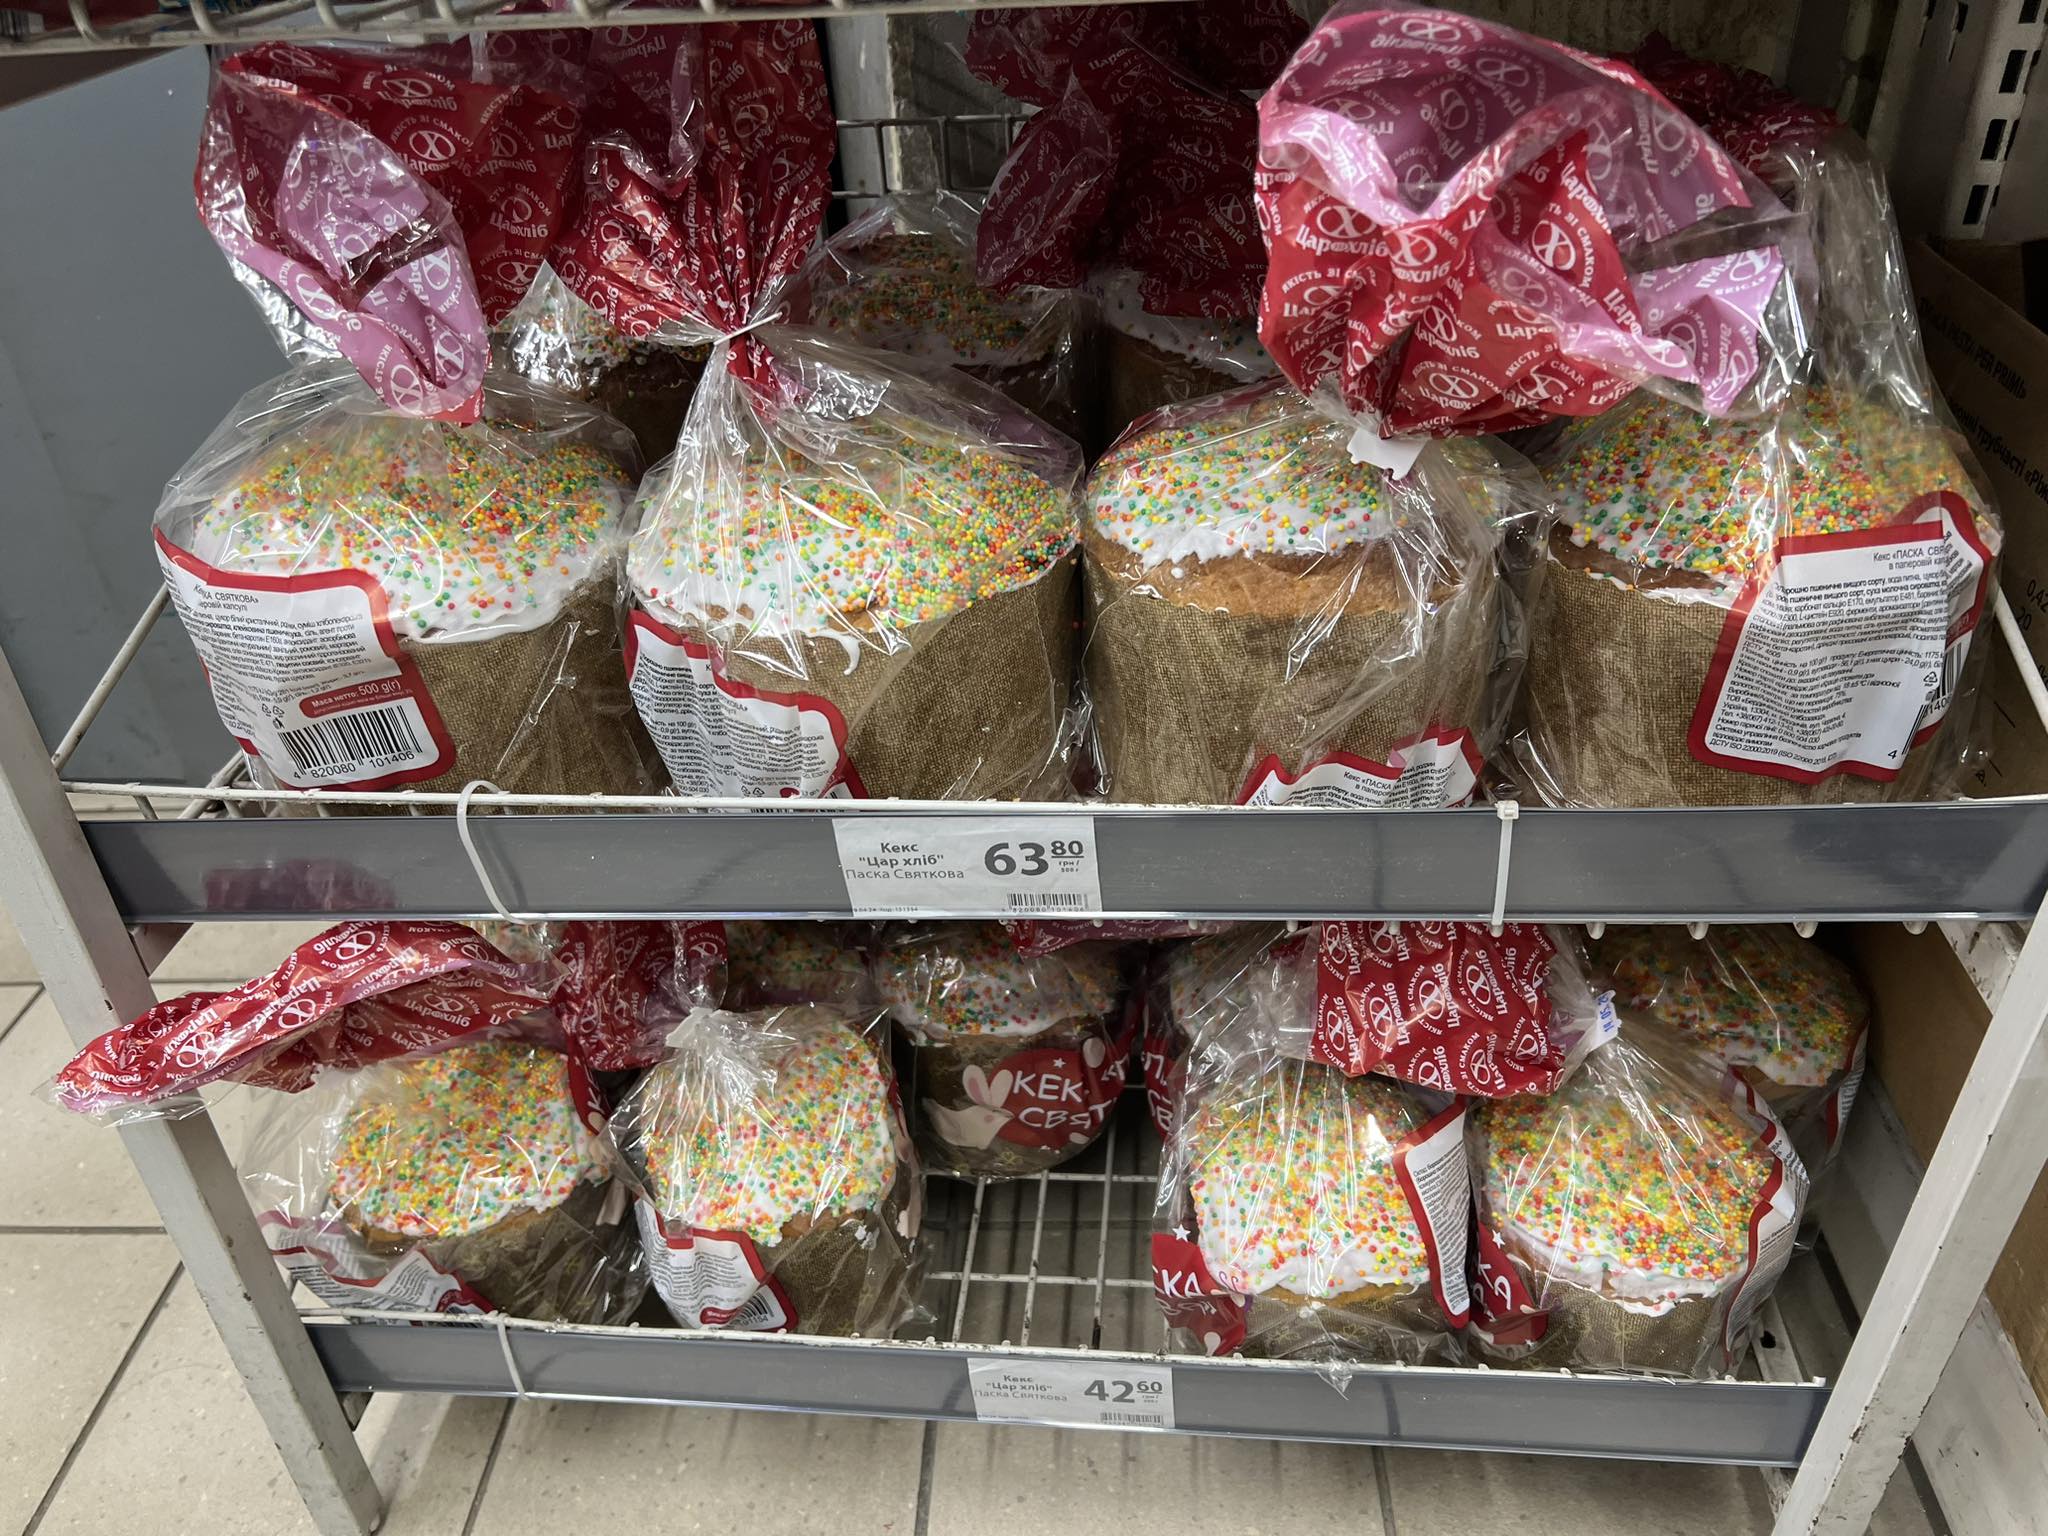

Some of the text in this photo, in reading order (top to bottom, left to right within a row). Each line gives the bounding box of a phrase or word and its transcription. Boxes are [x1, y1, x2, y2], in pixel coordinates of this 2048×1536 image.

[1564, 212, 1595, 288] ЗІ СМАКОМ
[1282, 268, 1340, 294] ЯКІСТЬ ЗІ
[1505, 349, 1540, 377] ЯКІСТЬ
[1544, 342, 1558, 352] ЗІ
[1451, 366, 1502, 394] СМАКОМ
[1873, 549, 1923, 562] Кекс «ПАСКА
[1895, 559, 1932, 571] паперовій
[1790, 593, 1823, 604] пшеничне
[1824, 590, 1849, 601] вищого
[1866, 587, 1881, 597] суха
[1882, 584, 1909, 594] молочна
[1810, 582, 1842, 593] пшеничне
[1843, 580, 1867, 591] вищого
[1868, 577, 1886, 588] сорту,
[214, 592, 259, 604] СВЯТКОВА»
[223, 603, 248, 613] капсулі
[1925, 651, 1939, 659] 1175
[311, 696, 334, 710] Маса
[334, 691, 358, 702] нетто:
[358, 683, 379, 697] 500
[1709, 738, 1728, 748] ДСТУ
[1729, 742, 1742, 750] ISO
[293, 750, 415, 779] 4 820080 101406
[1887, 749, 1898, 760] 4
[1343, 771, 1360, 782] Кекс
[880, 842, 919, 854] Кекс
[984, 840, 1083, 876] 63 80
[858, 854, 945, 869] "Цар хліб"
[846, 867, 965, 880] Паска Святкова
[1322, 956, 1345, 980] ЯКІСТЬ
[1457, 948, 1470, 984] СМАКОМ
[1407, 964, 1425, 1013] ЗІ СМАКОМ
[1360, 981, 1393, 1053] ЯКІСТЬ ЗІ СМАКОМ
[1467, 997, 1494, 1022] ЯКІСТЬ
[1318, 993, 1346, 1068] ЯКІСТЬ ЗІ СМАКОМ
[1506, 1016, 1526, 1050] СМАКОМ
[1458, 1032, 1481, 1069] СМАКОМ
[1461, 1071, 1468, 1080] ЗІ
[985, 1382, 1053, 1392] "Цар хліб"
[1003, 1374, 1033, 1383] Кекс
[974, 1389, 1068, 1401] Паска Святкова
[1084, 1379, 1163, 1403] 42 60
